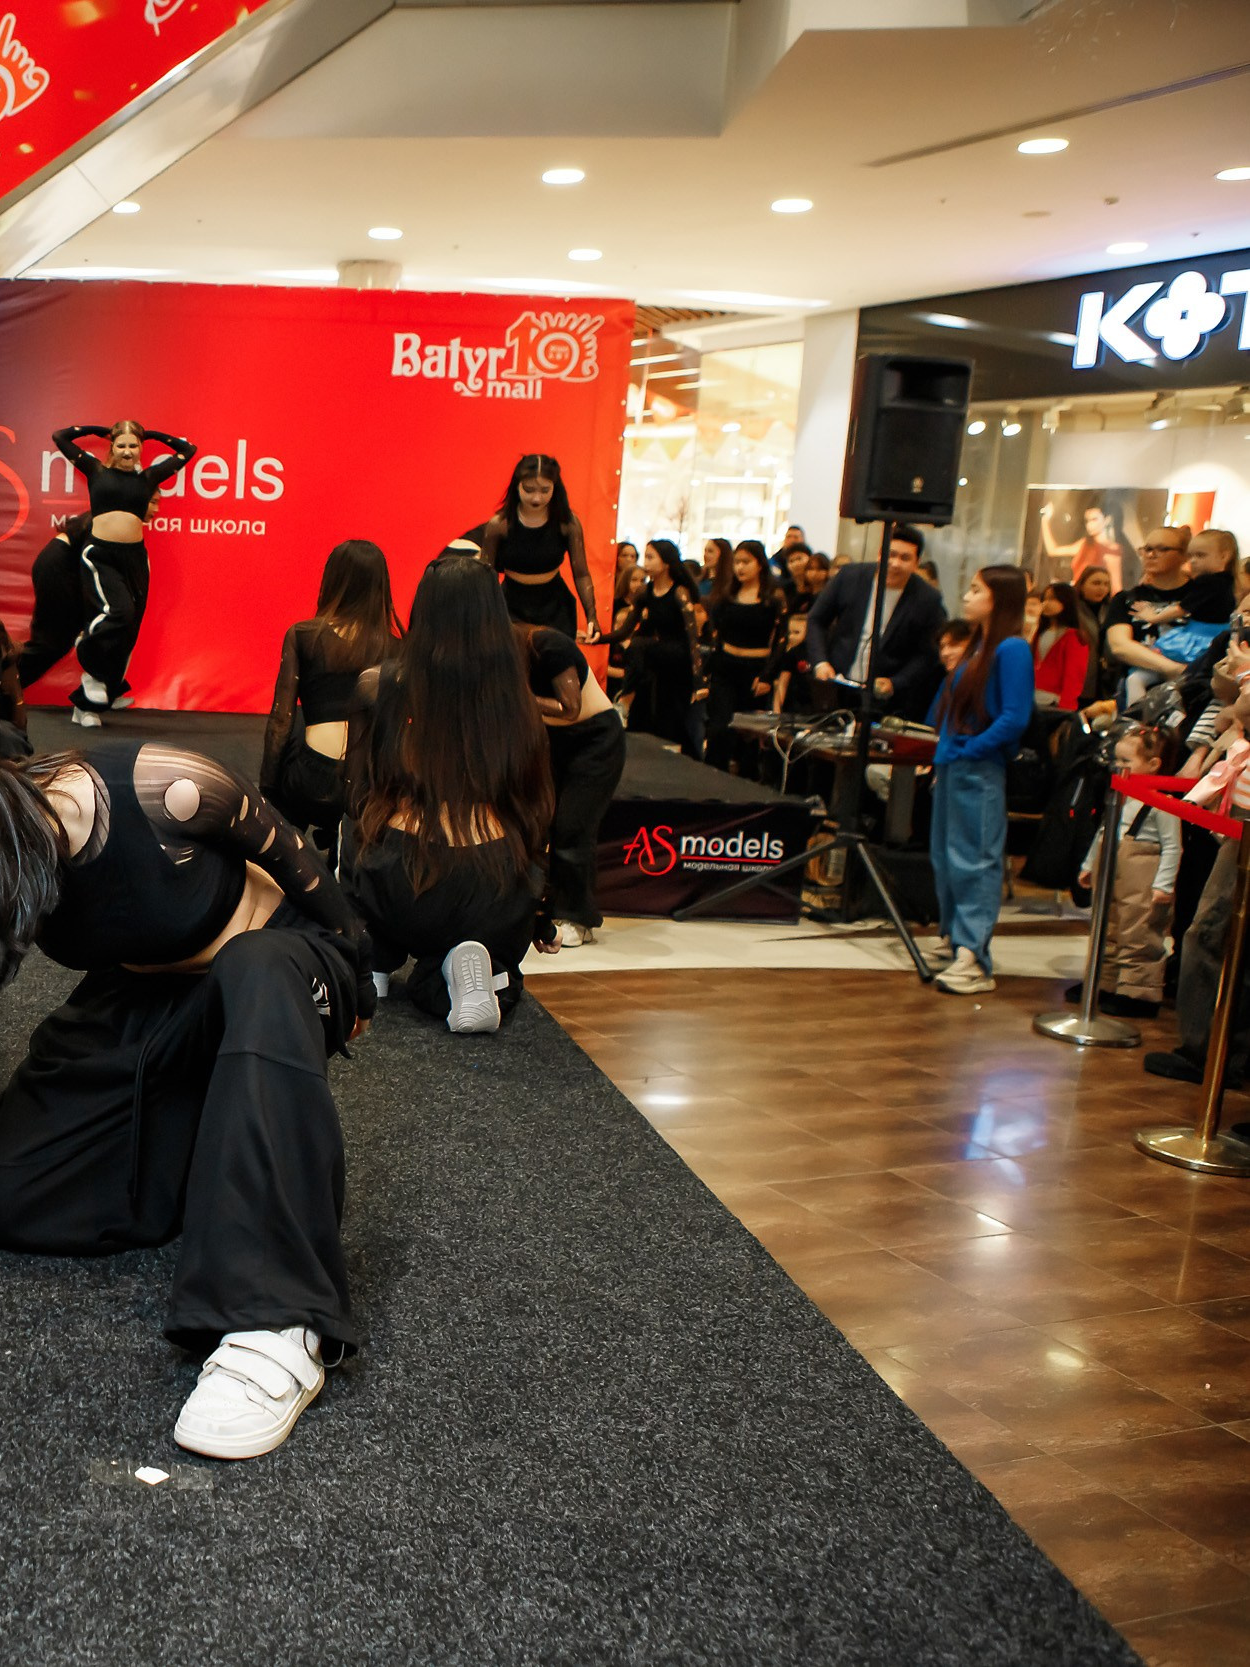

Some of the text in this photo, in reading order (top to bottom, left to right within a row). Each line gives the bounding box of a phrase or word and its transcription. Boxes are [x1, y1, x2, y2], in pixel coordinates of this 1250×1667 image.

[391, 332, 507, 398] Batyr
[486, 379, 543, 400] mall
[41, 436, 284, 501] mdels
[190, 517, 266, 536] школа
[623, 825, 784, 876] AS models
